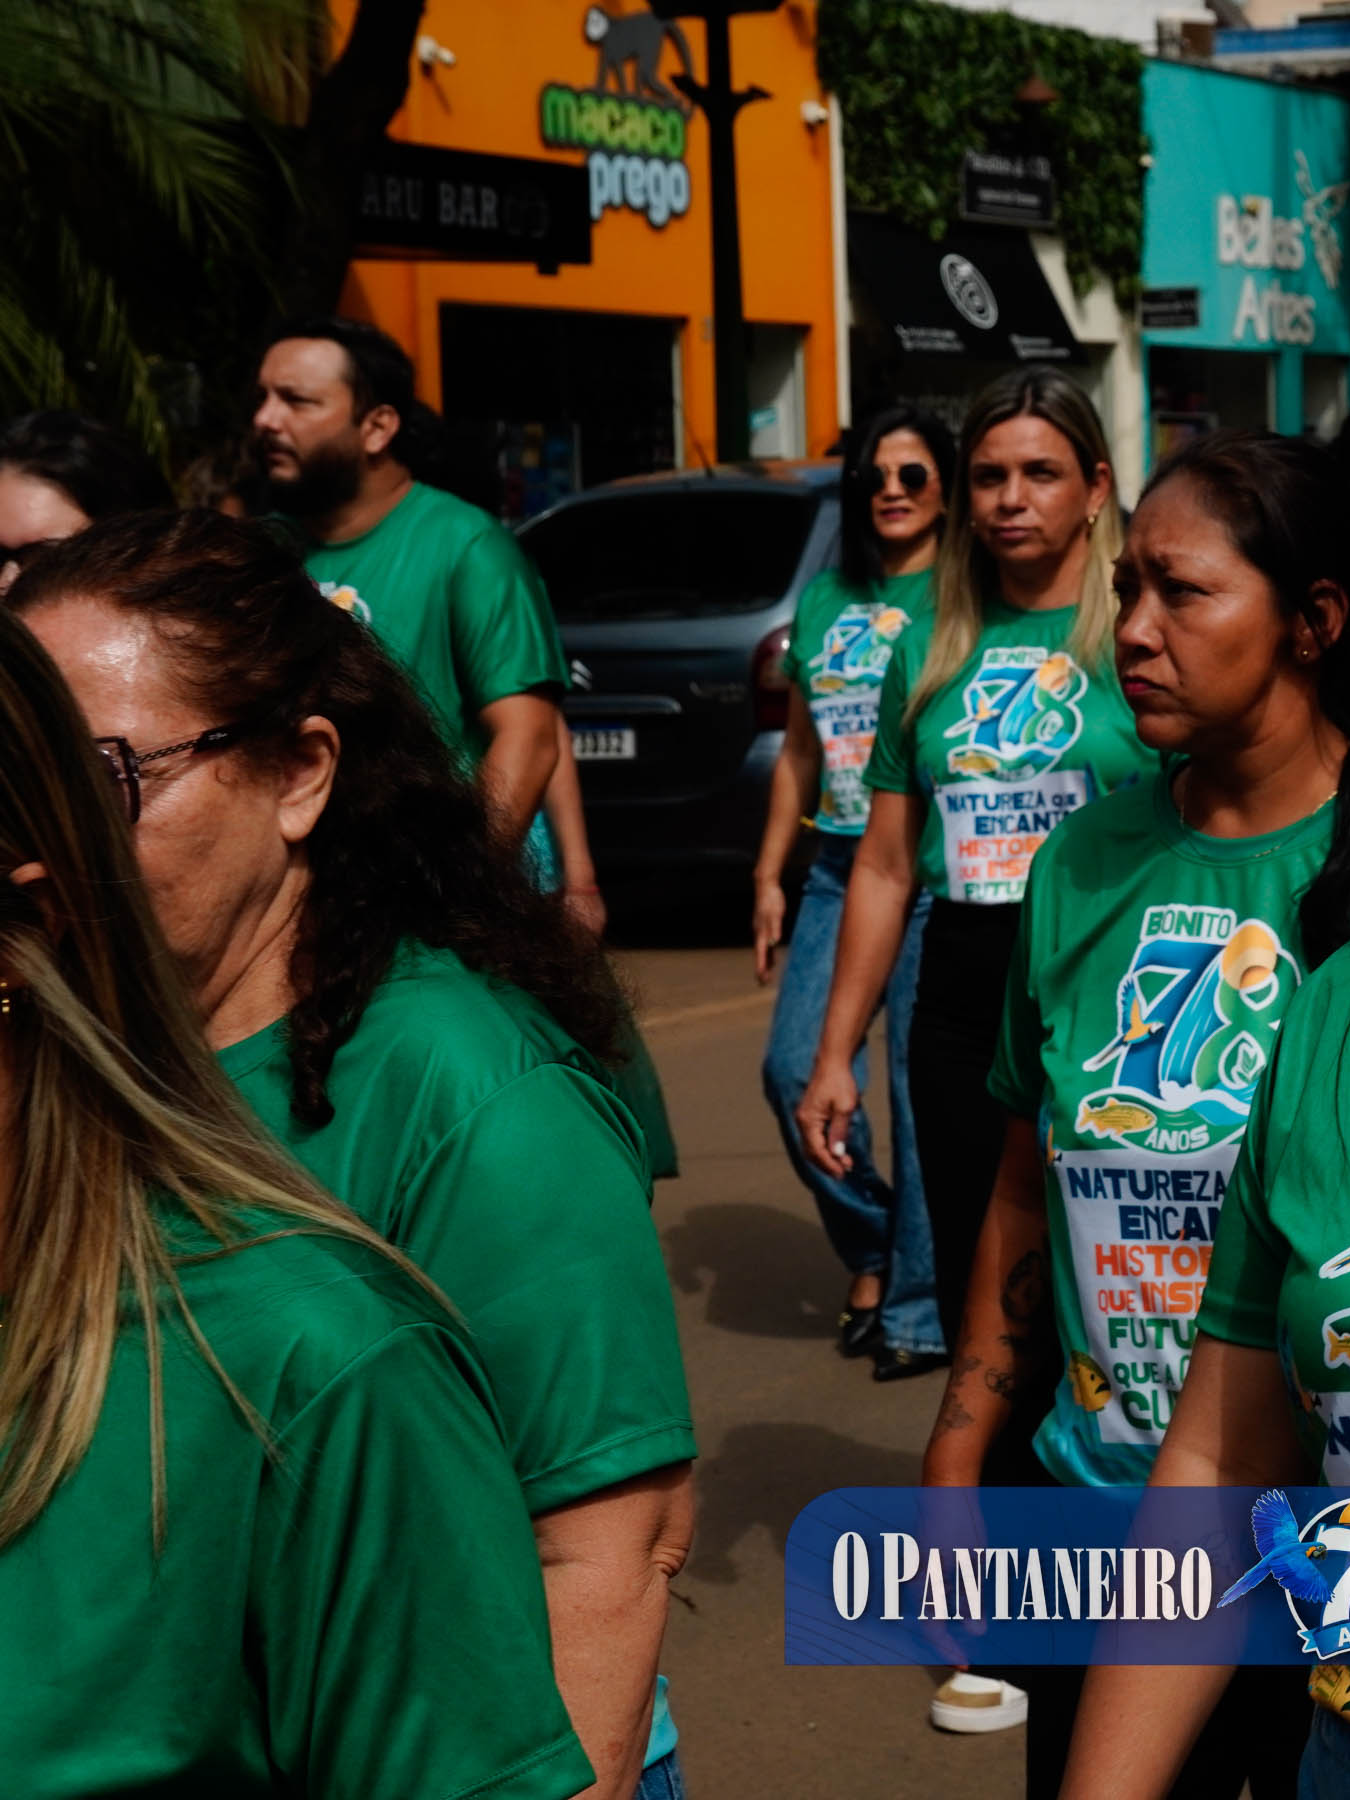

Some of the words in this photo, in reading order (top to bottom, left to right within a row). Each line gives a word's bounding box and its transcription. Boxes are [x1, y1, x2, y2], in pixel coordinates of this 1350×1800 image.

[542, 86, 686, 159] macaco
[437, 180, 500, 230] BAR
[589, 153, 689, 227] prego
[1233, 275, 1316, 345] Artes
[966, 652, 1088, 752] 78
[945, 791, 1046, 812] NATUREZA
[975, 811, 1071, 835] ENCANT
[964, 880, 1026, 901] FUTU
[1145, 909, 1232, 939] BONITO
[1112, 918, 1303, 1112] 78
[1144, 1124, 1210, 1152] ANOS
[1066, 1167, 1227, 1202] NATUREZA
[1098, 1290, 1136, 1315] QUE
[1108, 1317, 1197, 1349] FUTU
[1113, 1363, 1159, 1387] QUE
[1164, 1365, 1178, 1386] A
